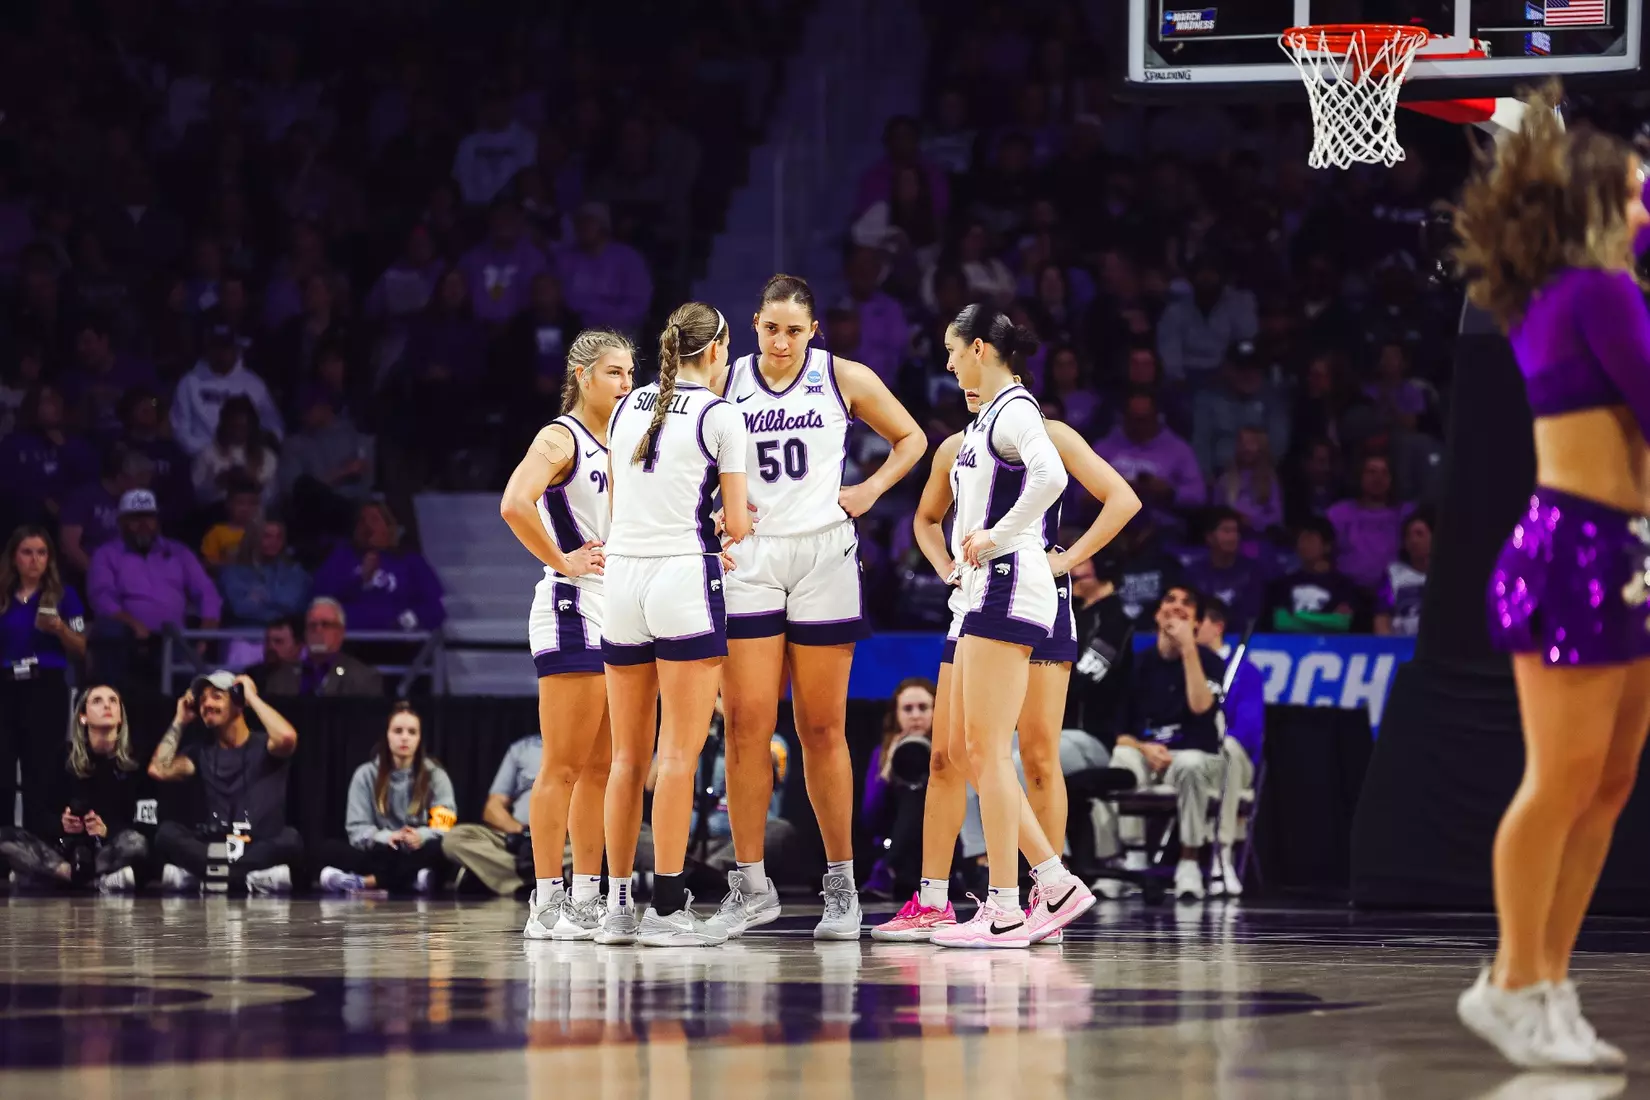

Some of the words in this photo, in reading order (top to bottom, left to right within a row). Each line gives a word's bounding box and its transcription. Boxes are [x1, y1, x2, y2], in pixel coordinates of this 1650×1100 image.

[1144, 70, 1191, 81] SPALDING
[634, 391, 690, 415] SUNELL
[742, 408, 824, 434] Wildcats
[756, 437, 809, 484] 50
